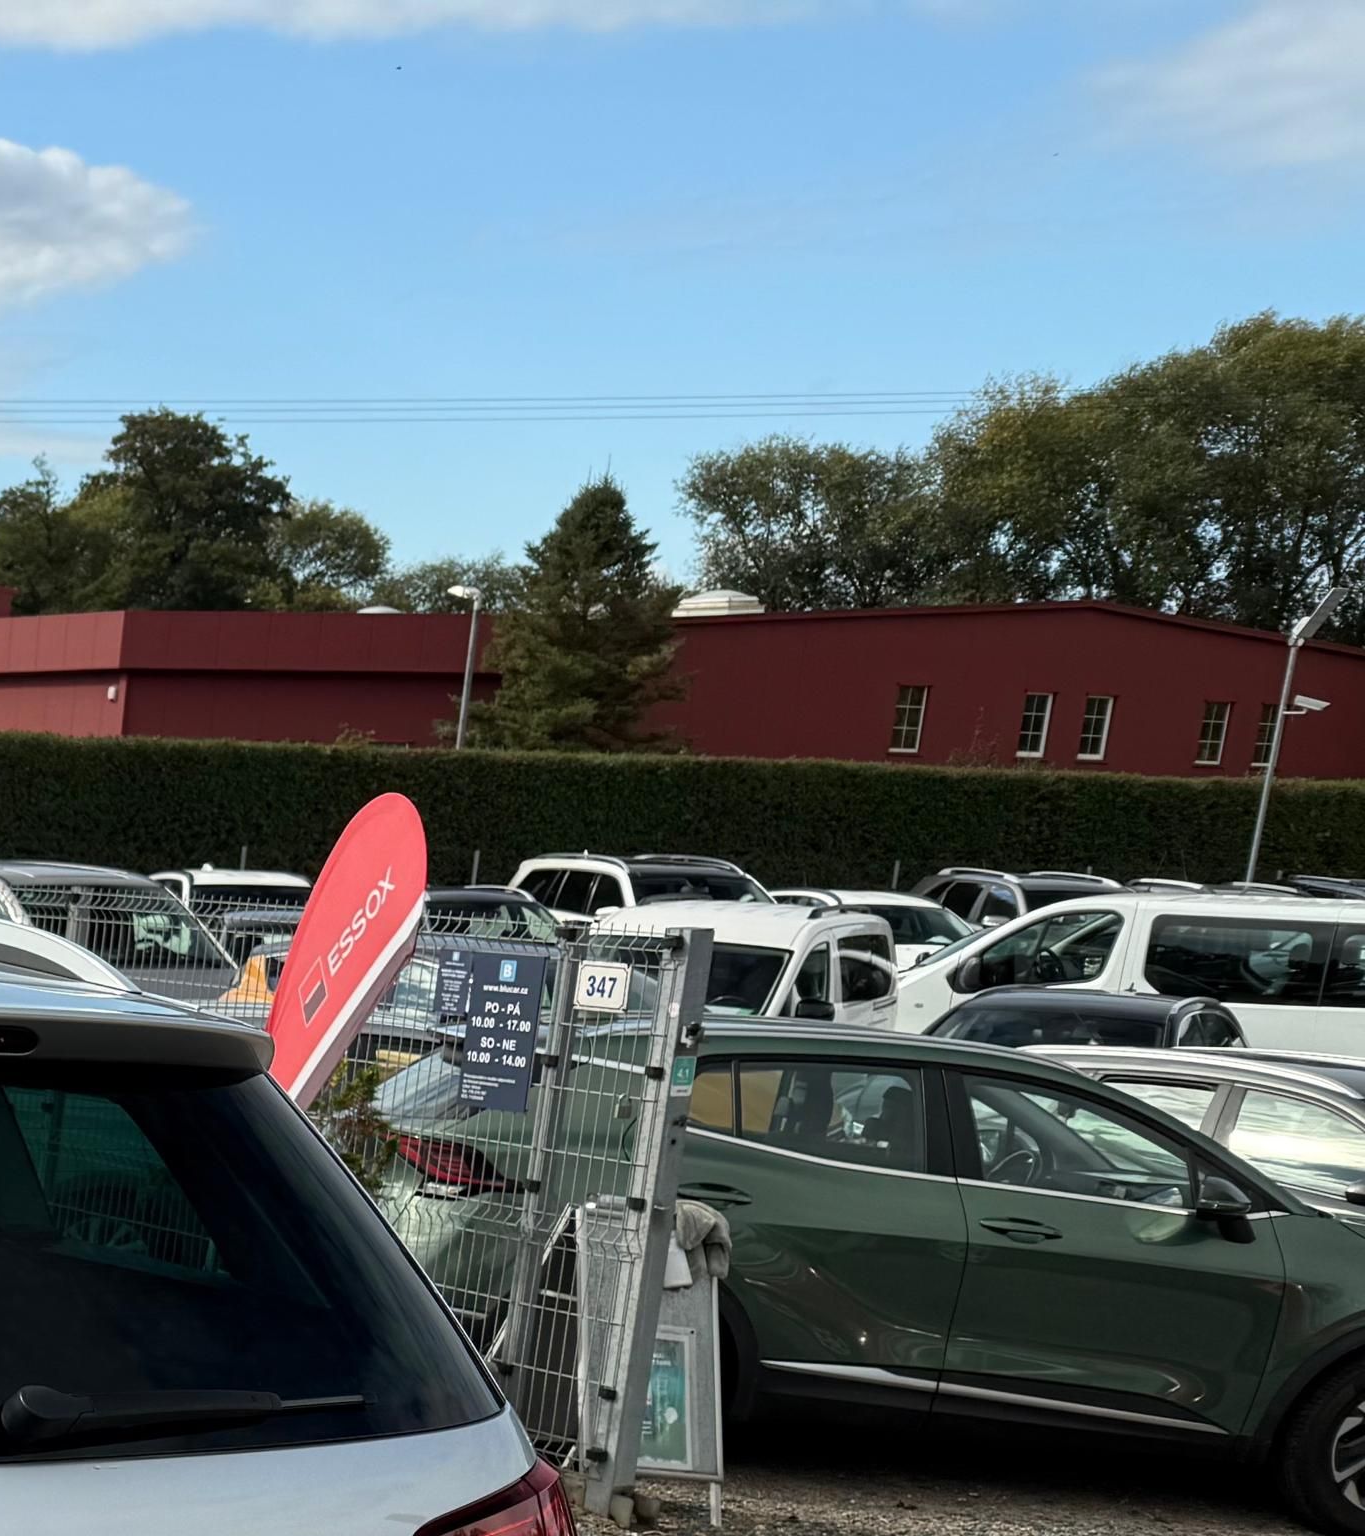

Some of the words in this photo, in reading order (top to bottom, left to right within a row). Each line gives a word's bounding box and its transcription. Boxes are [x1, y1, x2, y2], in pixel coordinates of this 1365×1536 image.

[327, 864, 396, 977] ESSOX
[503, 963, 513, 978] B
[586, 974, 618, 999] 347
[484, 1001, 500, 1013] PO
[506, 1001, 521, 1016] PÁ
[471, 1016, 495, 1029] 10.00
[507, 1019, 531, 1033] 17.00
[480, 1036, 495, 1049] SO
[502, 1039, 517, 1051] NE
[467, 1050, 491, 1063] 10.00
[502, 1054, 526, 1068] 14.00
